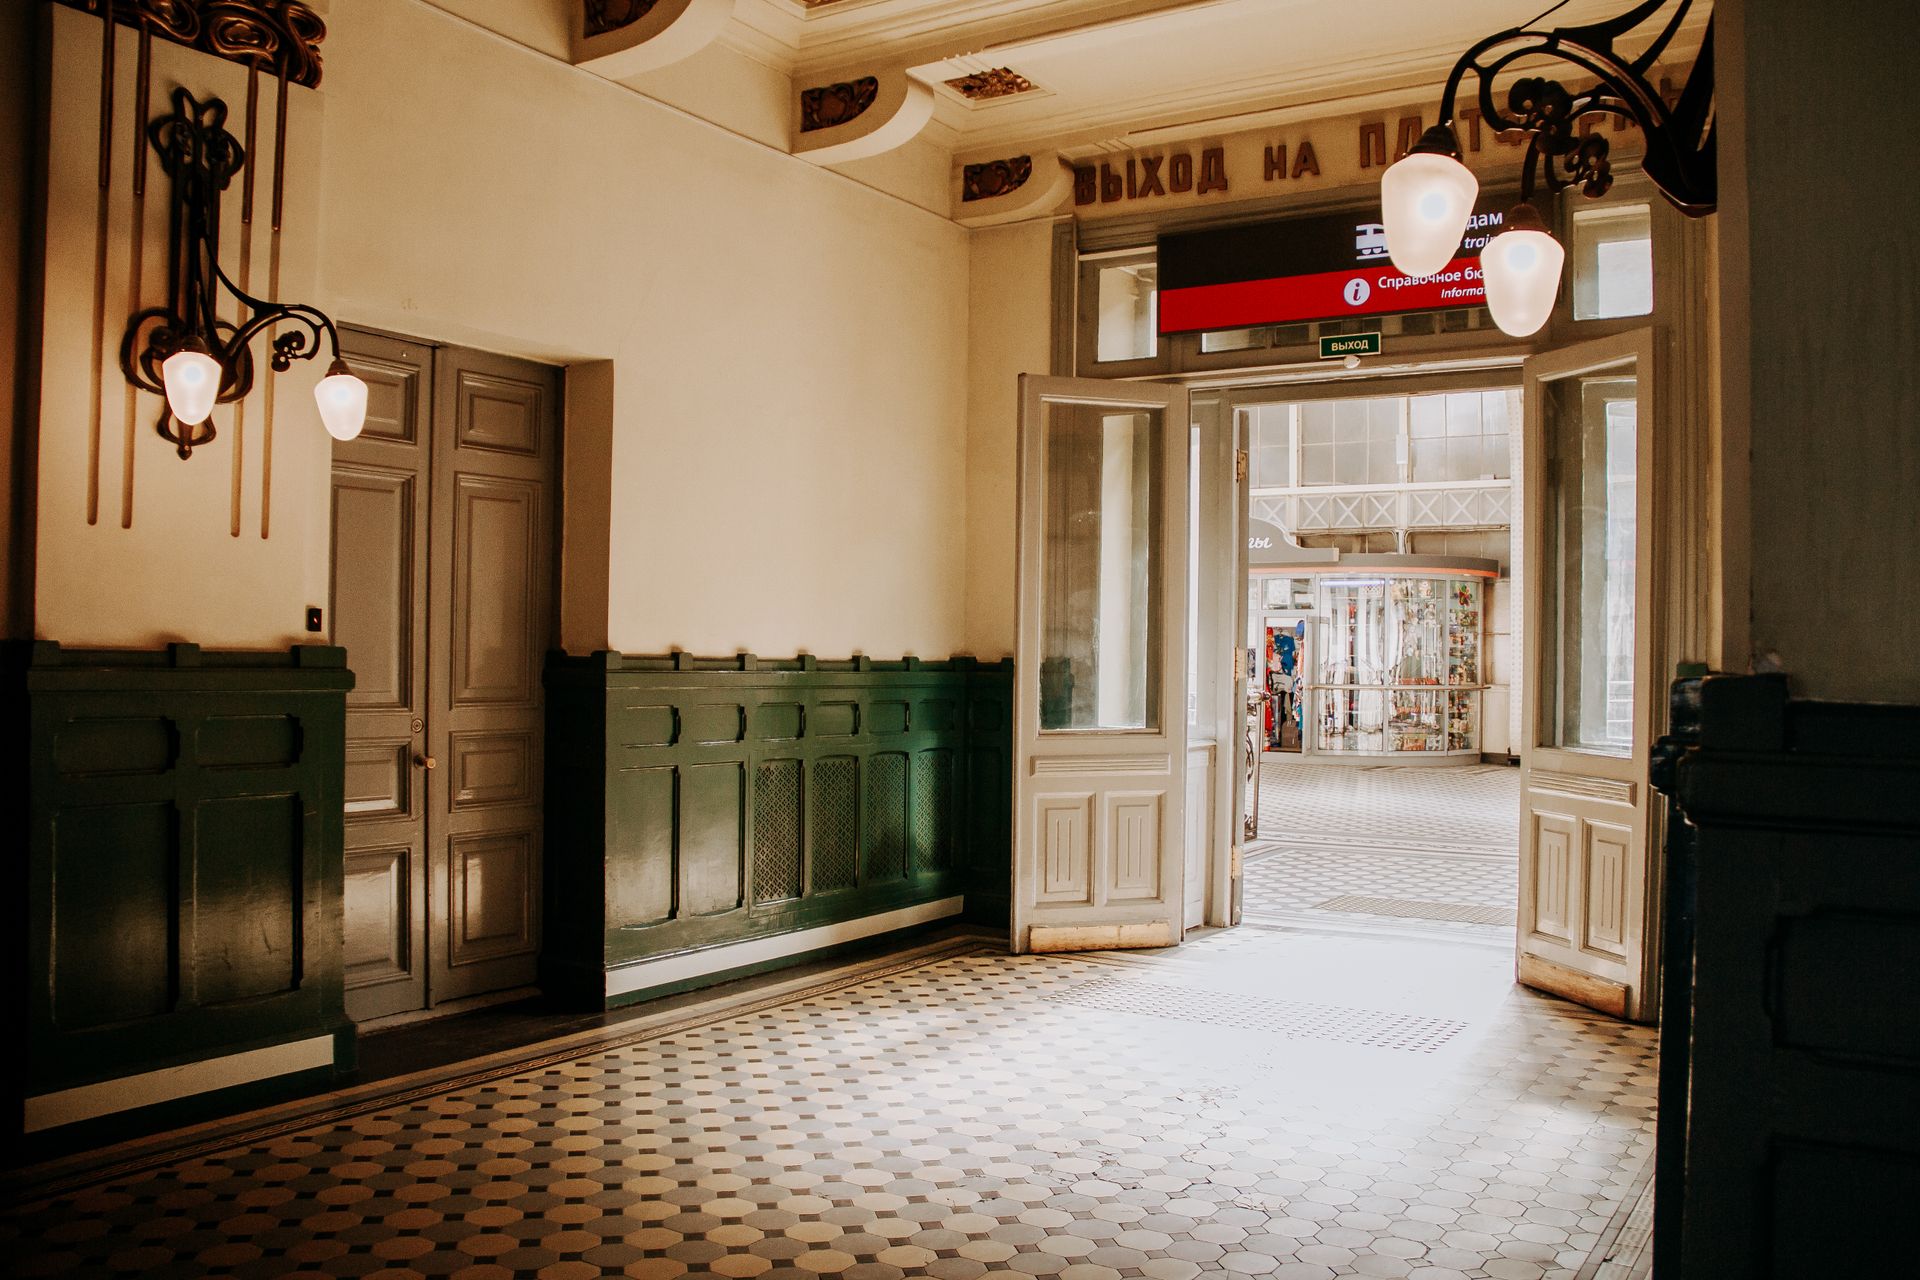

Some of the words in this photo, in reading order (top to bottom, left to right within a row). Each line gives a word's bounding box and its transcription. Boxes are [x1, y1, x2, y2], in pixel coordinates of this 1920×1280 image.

[1074, 145, 1229, 206] ВЫХОД
[1263, 140, 1321, 182] НА
[1466, 211, 1503, 231] дам
[1464, 233, 1495, 249] trai
[1377, 271, 1462, 291] Справочное
[1464, 266, 1484, 281] бю
[1440, 286, 1486, 299] Informa
[1331, 339, 1370, 352] ВЫХОД
